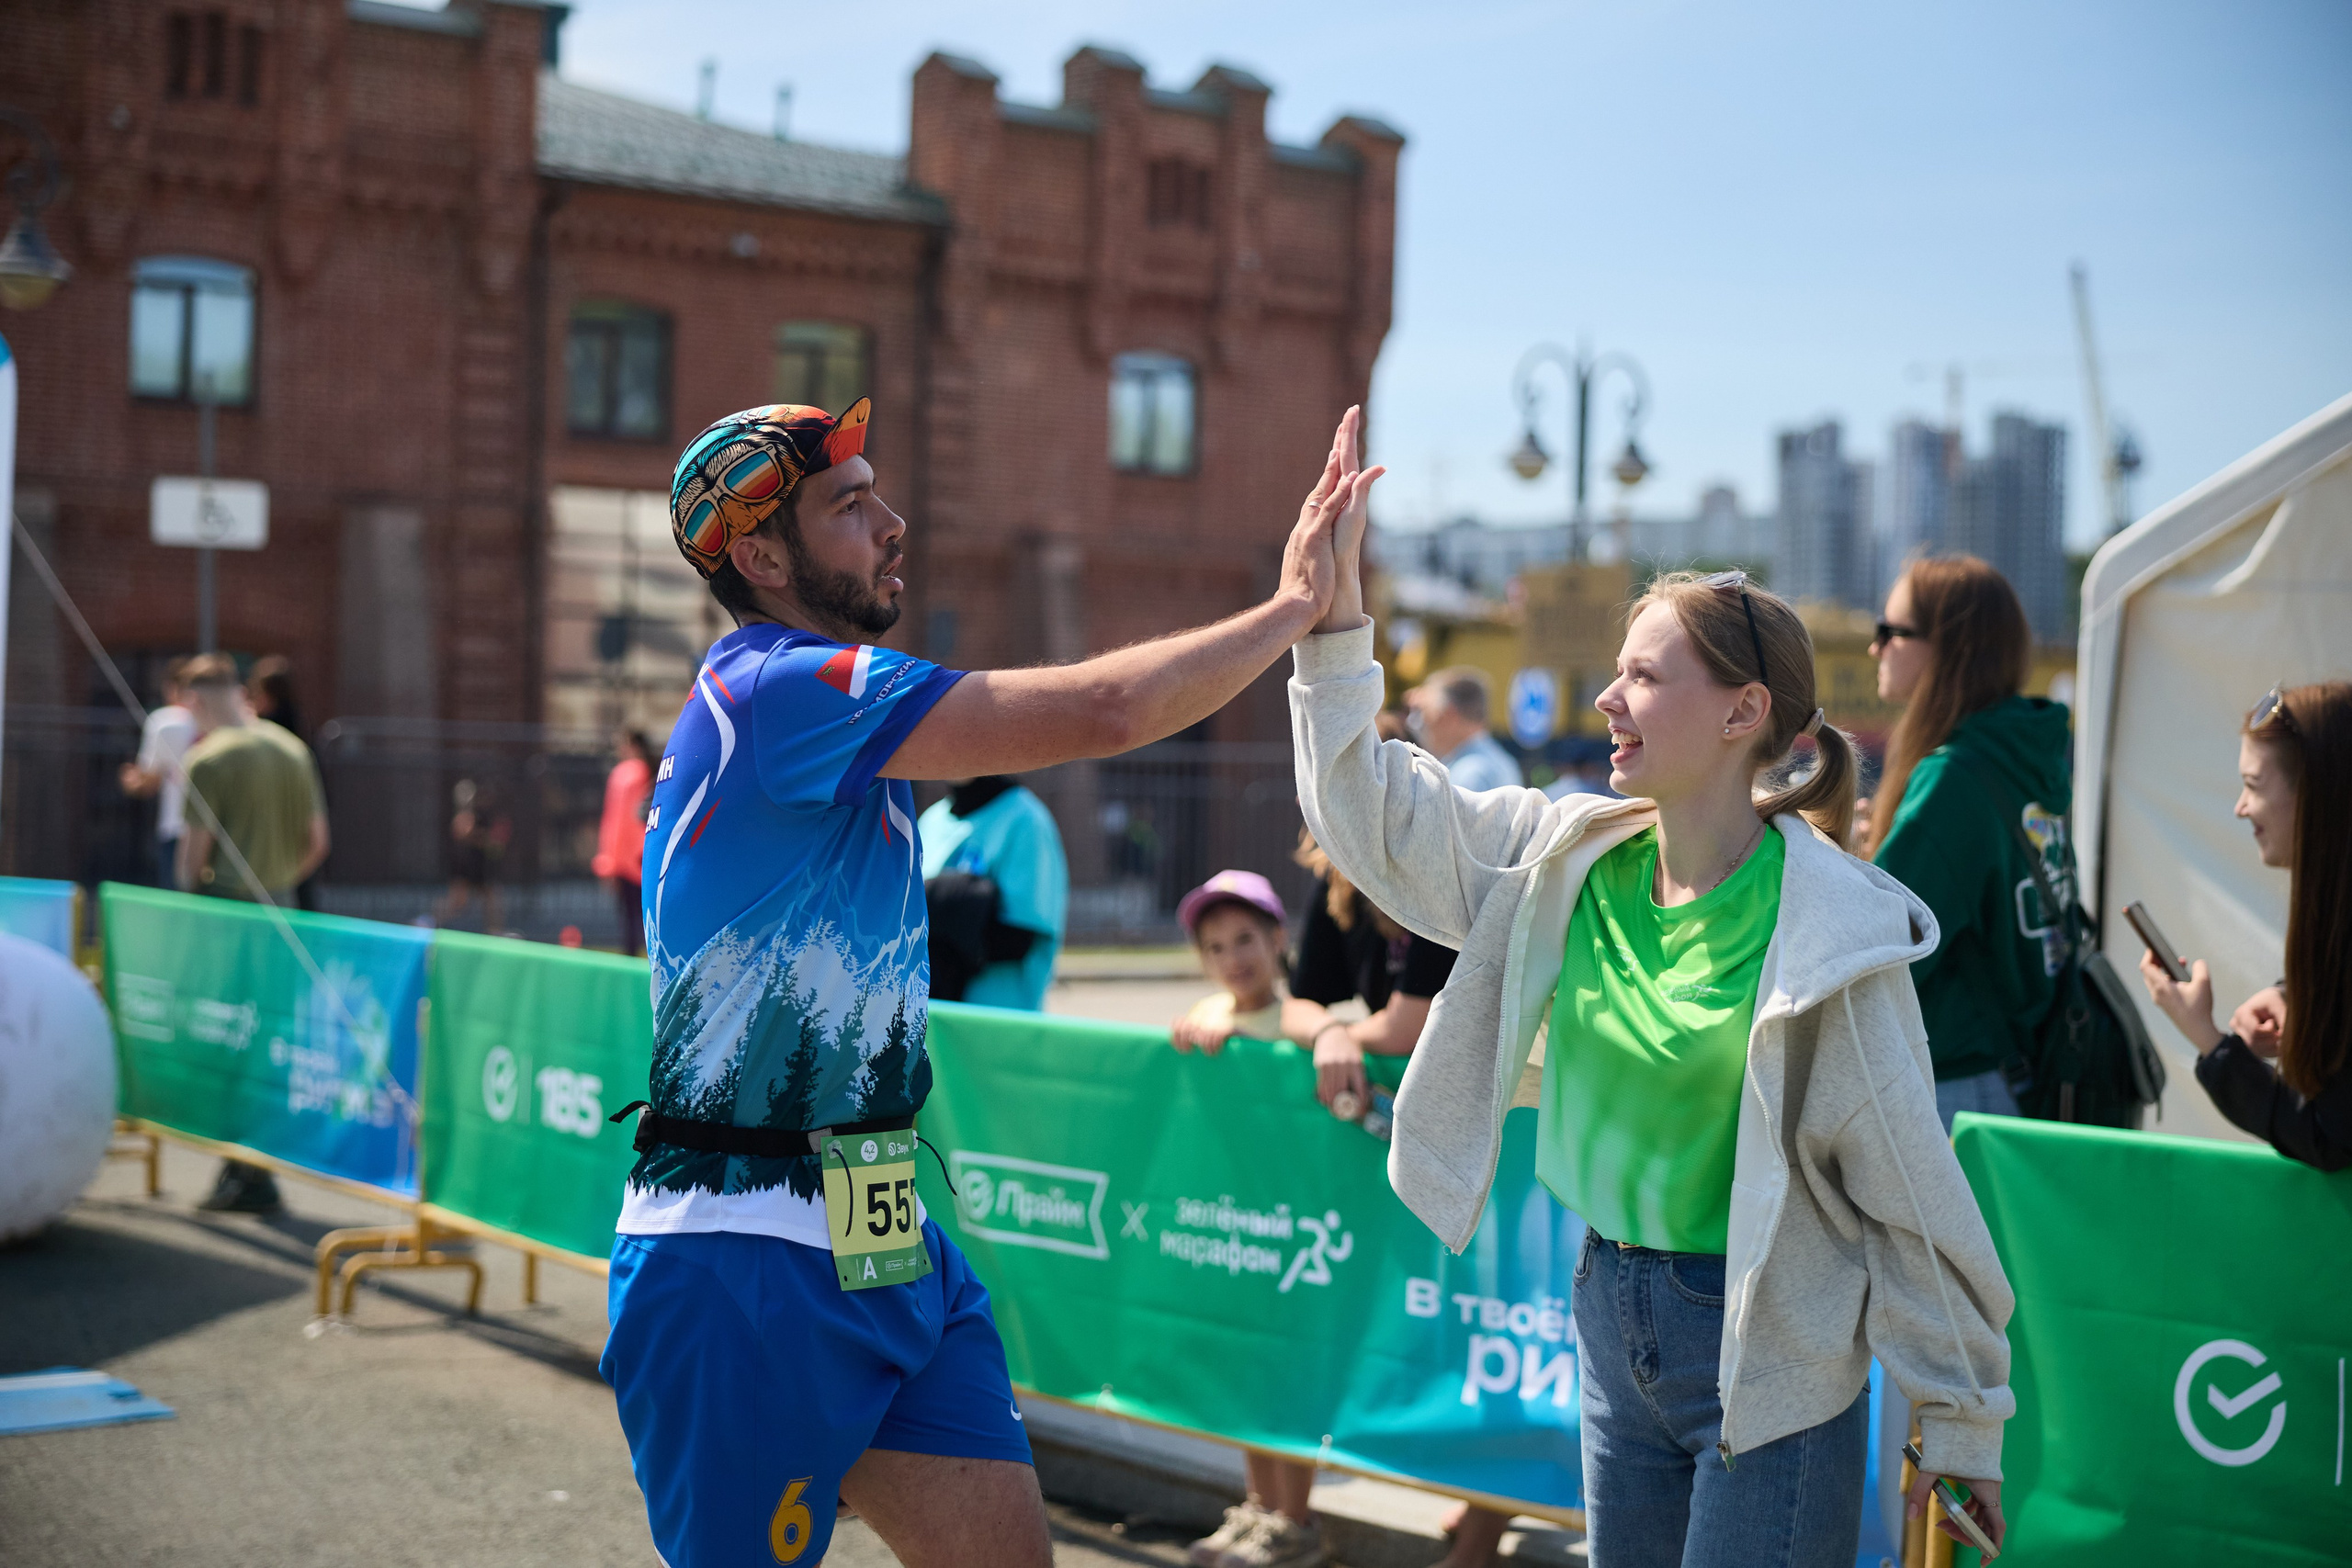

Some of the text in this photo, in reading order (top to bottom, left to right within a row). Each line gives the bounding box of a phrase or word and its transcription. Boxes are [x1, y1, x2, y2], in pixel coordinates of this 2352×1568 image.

[848, 660, 916, 724] ПРМОРСКИ
[535, 1066, 603, 1139] 185
[1405, 1276, 1441, 1318] В
[1460, 1334, 1577, 1408] ри
[768, 1475, 813, 1565] 6
